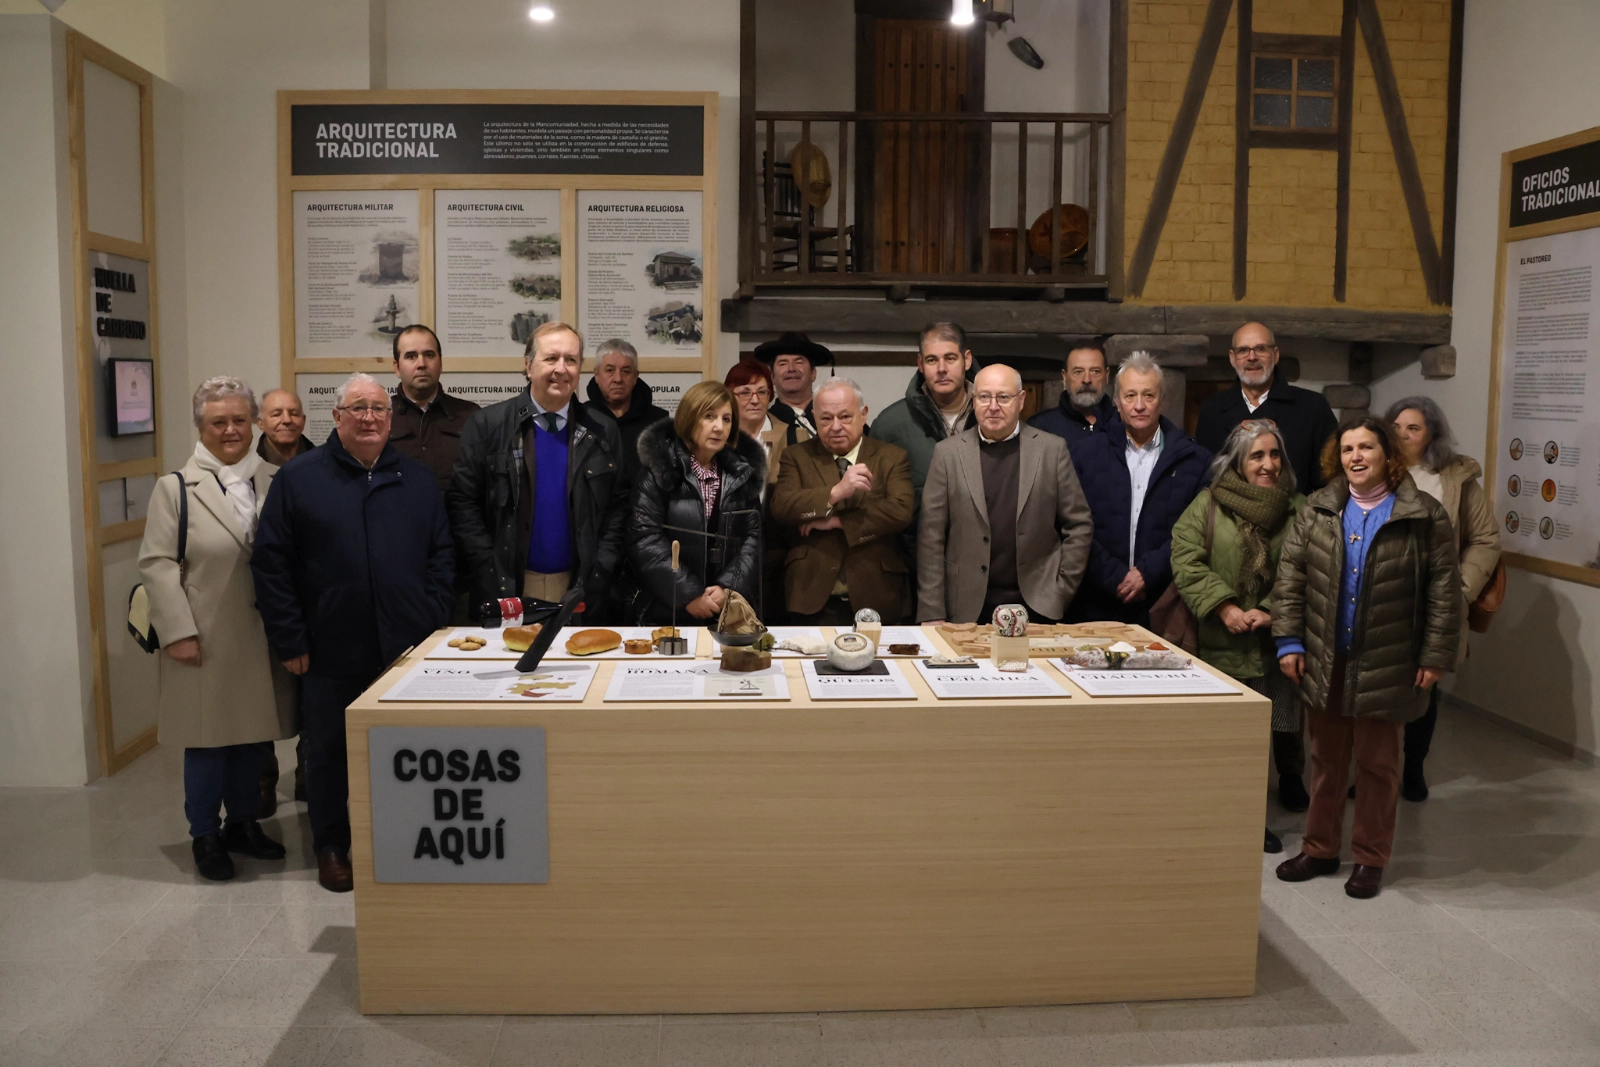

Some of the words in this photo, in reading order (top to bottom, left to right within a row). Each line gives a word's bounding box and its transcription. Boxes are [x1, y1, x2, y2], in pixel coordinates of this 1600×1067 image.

[315, 122, 457, 142] ARQUITECTURA
[315, 142, 439, 158] TRADICIONAL
[1522, 166, 1570, 193] OFICIOS
[1521, 179, 1600, 212] TRADICIONAL
[307, 204, 363, 212] ARQUITECTURA
[447, 204, 503, 212] ARQUITECTURA
[588, 204, 644, 213] ARQUITECTURA
[1526, 254, 1552, 264] PASTOREO
[94, 267, 136, 293] HUELLA
[96, 292, 112, 313] DE
[96, 316, 146, 340] CARBONO
[309, 387, 337, 395] ARQUIT
[447, 386, 503, 395] ARQUITECTURA
[393, 748, 521, 783] COSAS
[433, 788, 484, 821] DE
[414, 817, 506, 866] AQUÍ
